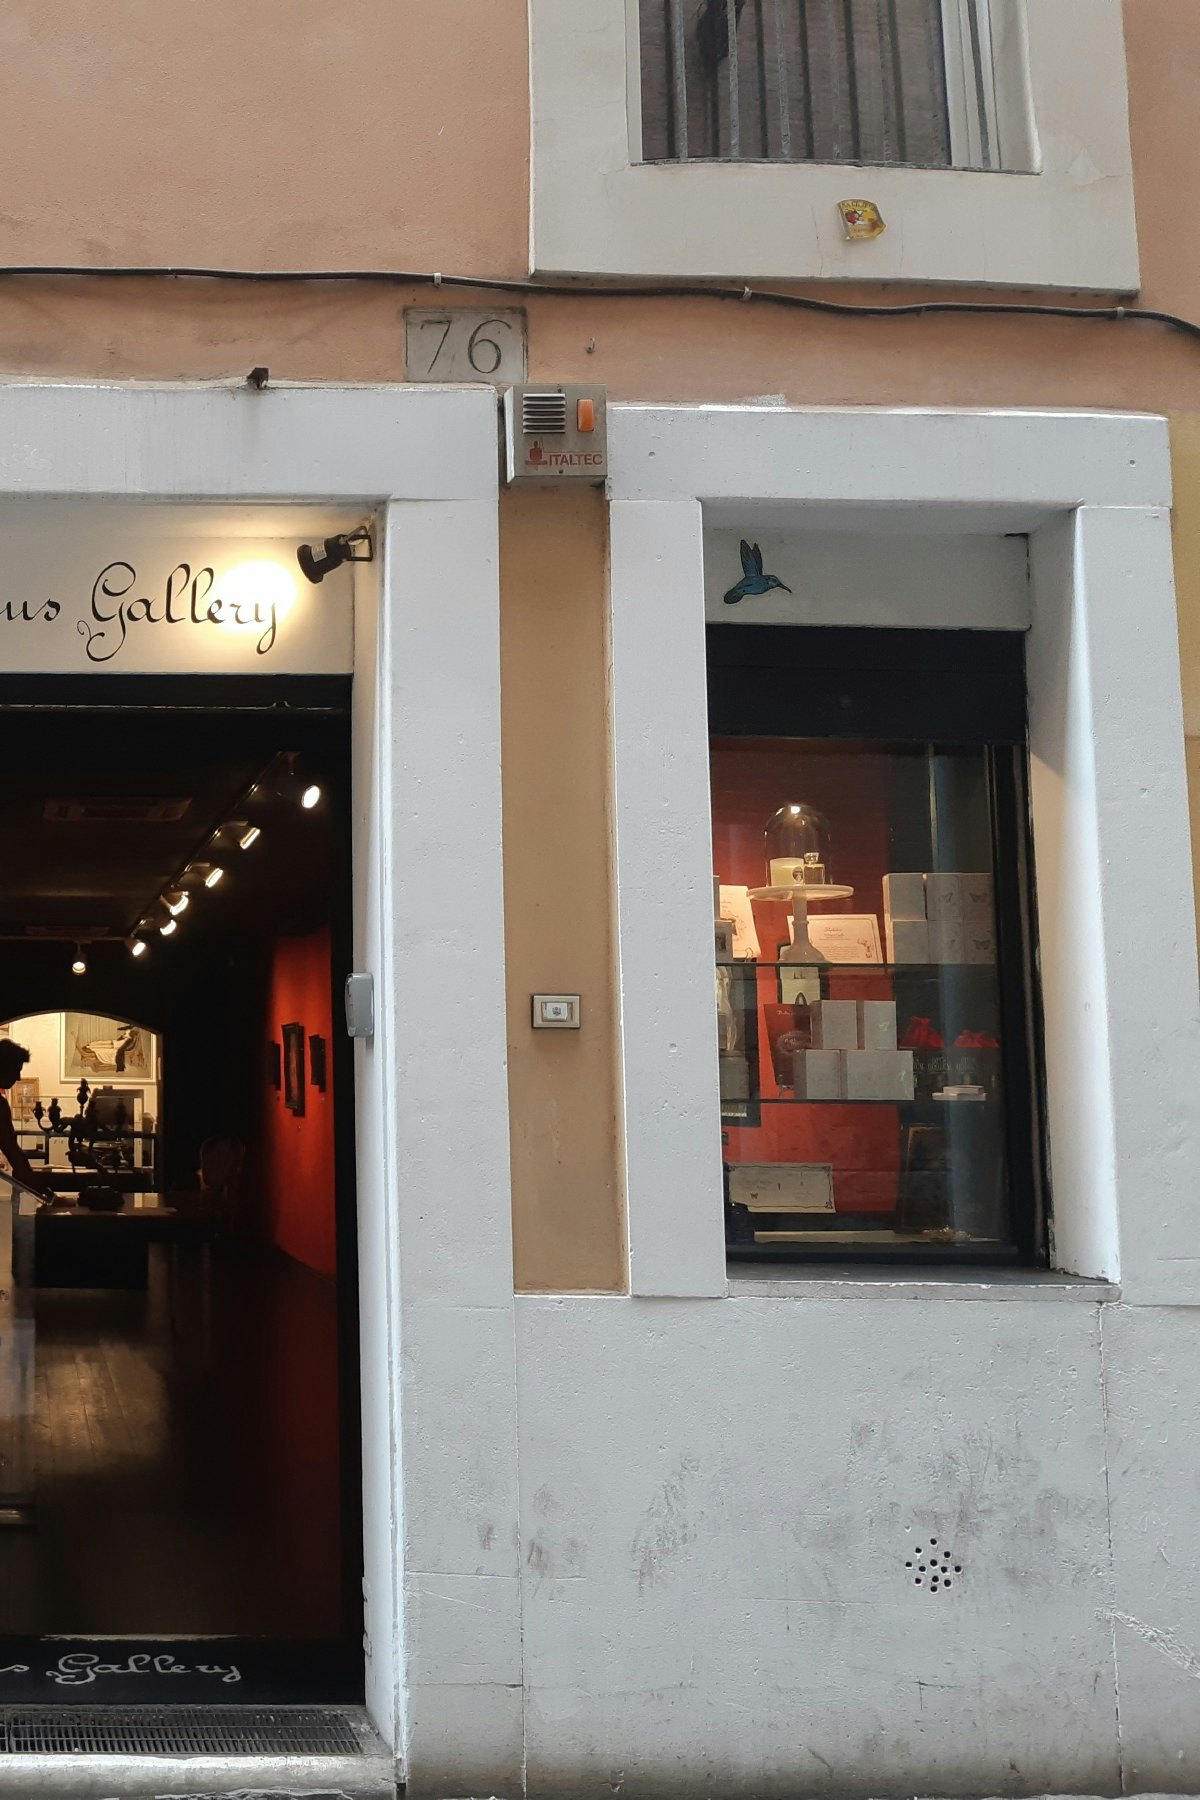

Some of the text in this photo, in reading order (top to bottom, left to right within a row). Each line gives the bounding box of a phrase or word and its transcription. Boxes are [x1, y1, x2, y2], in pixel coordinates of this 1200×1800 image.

[420, 319, 512, 374] 76
[549, 453, 603, 466] ITALTEC
[77, 561, 277, 663] Gallery
[46, 1653, 242, 1684] Gallery
